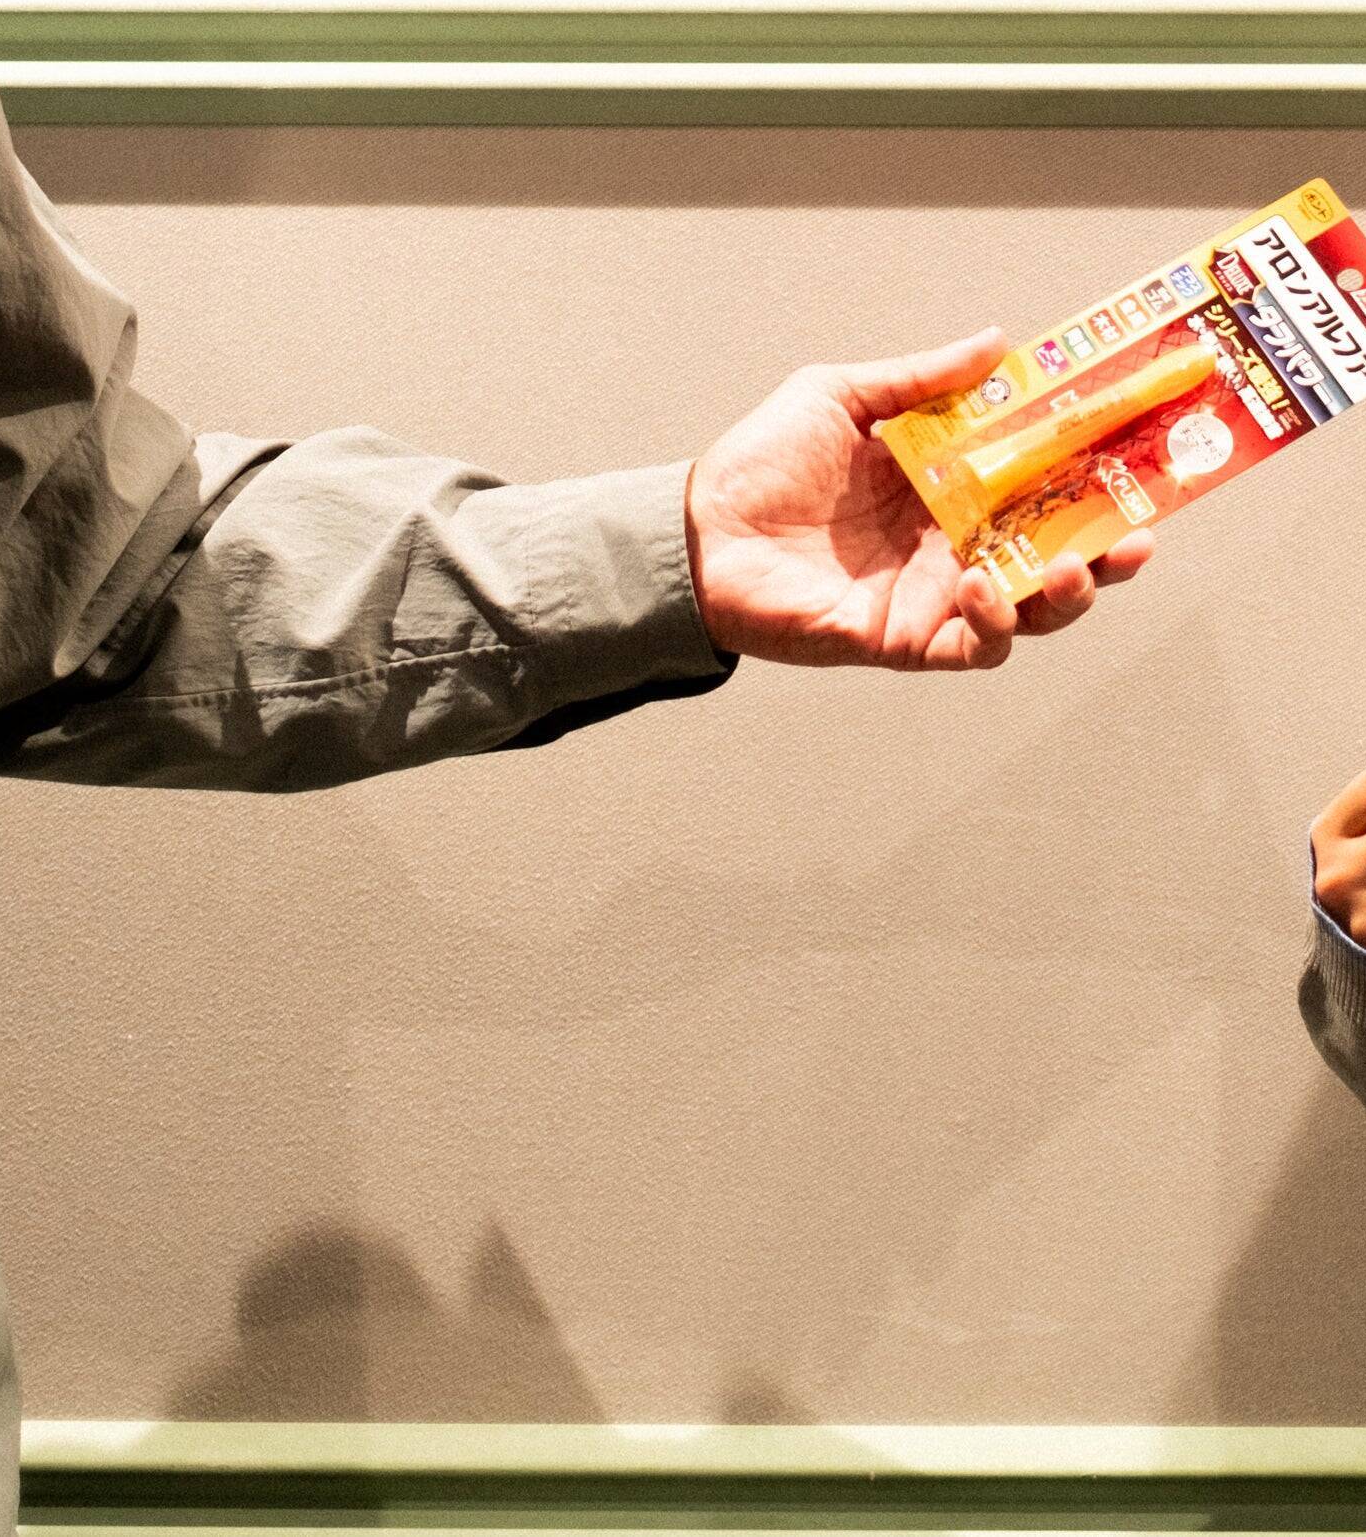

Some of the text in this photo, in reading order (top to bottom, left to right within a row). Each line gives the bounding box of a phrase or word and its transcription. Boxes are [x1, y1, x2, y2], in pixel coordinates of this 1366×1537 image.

[1216, 251, 1253, 297] DELUXE
[1248, 304, 1332, 405] タフパワー
[1113, 475, 1151, 517] PUSH
